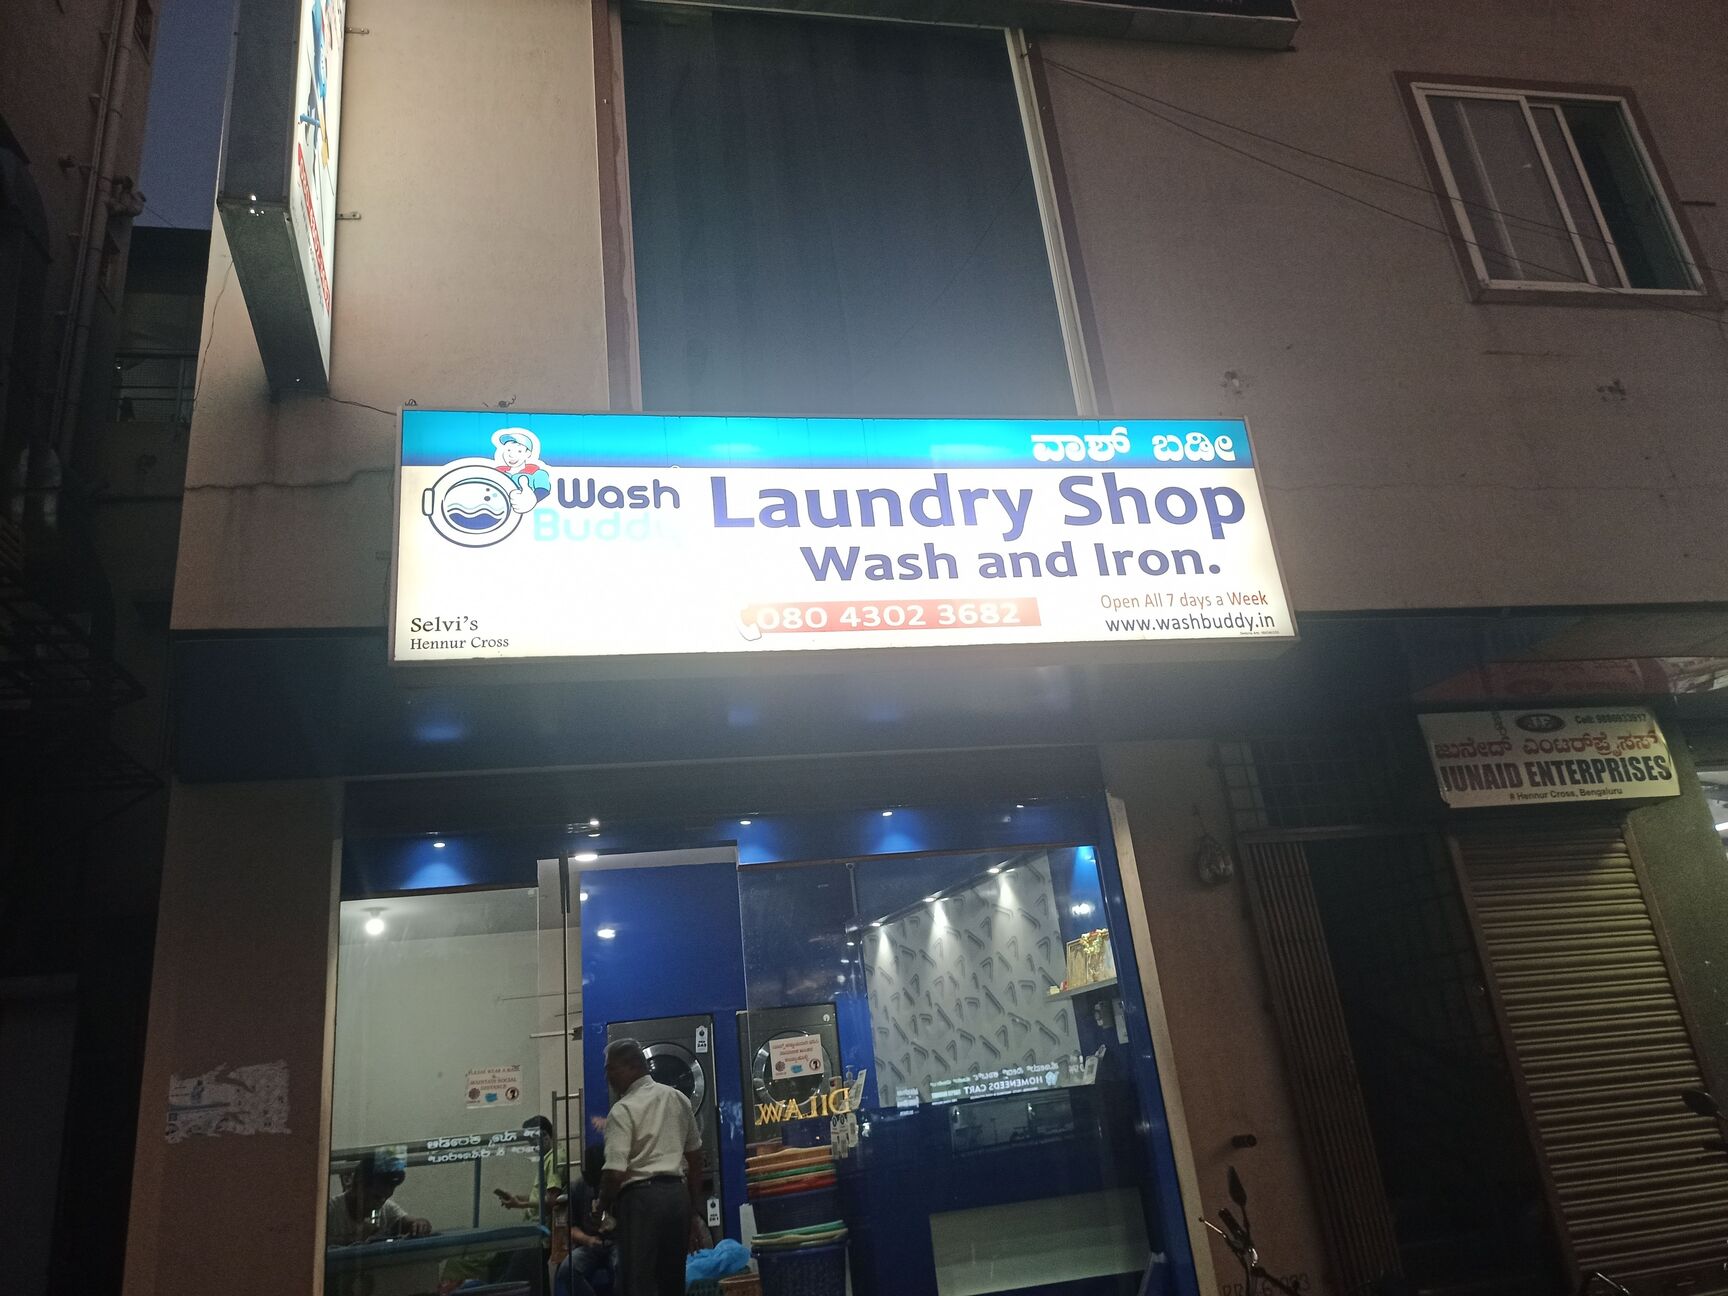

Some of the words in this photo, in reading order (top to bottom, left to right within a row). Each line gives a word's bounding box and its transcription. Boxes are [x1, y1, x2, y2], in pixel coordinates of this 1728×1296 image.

[1031, 426, 1131, 462] ವಾಶ್
[557, 478, 680, 510] Wash
[711, 473, 1033, 541] Laundry
[1059, 472, 1246, 539] Shop
[800, 542, 958, 582] Wash
[979, 541, 1077, 579] and
[1095, 542, 1222, 577] Iron.
[756, 607, 828, 630] 080
[839, 605, 927, 628] 4302
[937, 602, 1021, 625] 3682
[1101, 594, 1140, 612] Open
[1144, 592, 1162, 608] All
[1166, 593, 1175, 607] 7
[1179, 592, 1212, 610] days
[1216, 595, 1224, 606] a
[1226, 591, 1268, 606] Week
[1105, 612, 1276, 632] www.washbuddy.in
[410, 636, 467, 650] Hennur
[470, 635, 509, 649] Cross
[1441, 762, 1523, 793] JUNAID
[1526, 754, 1673, 788] ENTERPRISES
[1517, 791, 1548, 801] Hennur
[1579, 787, 1623, 798] Bengaluru
